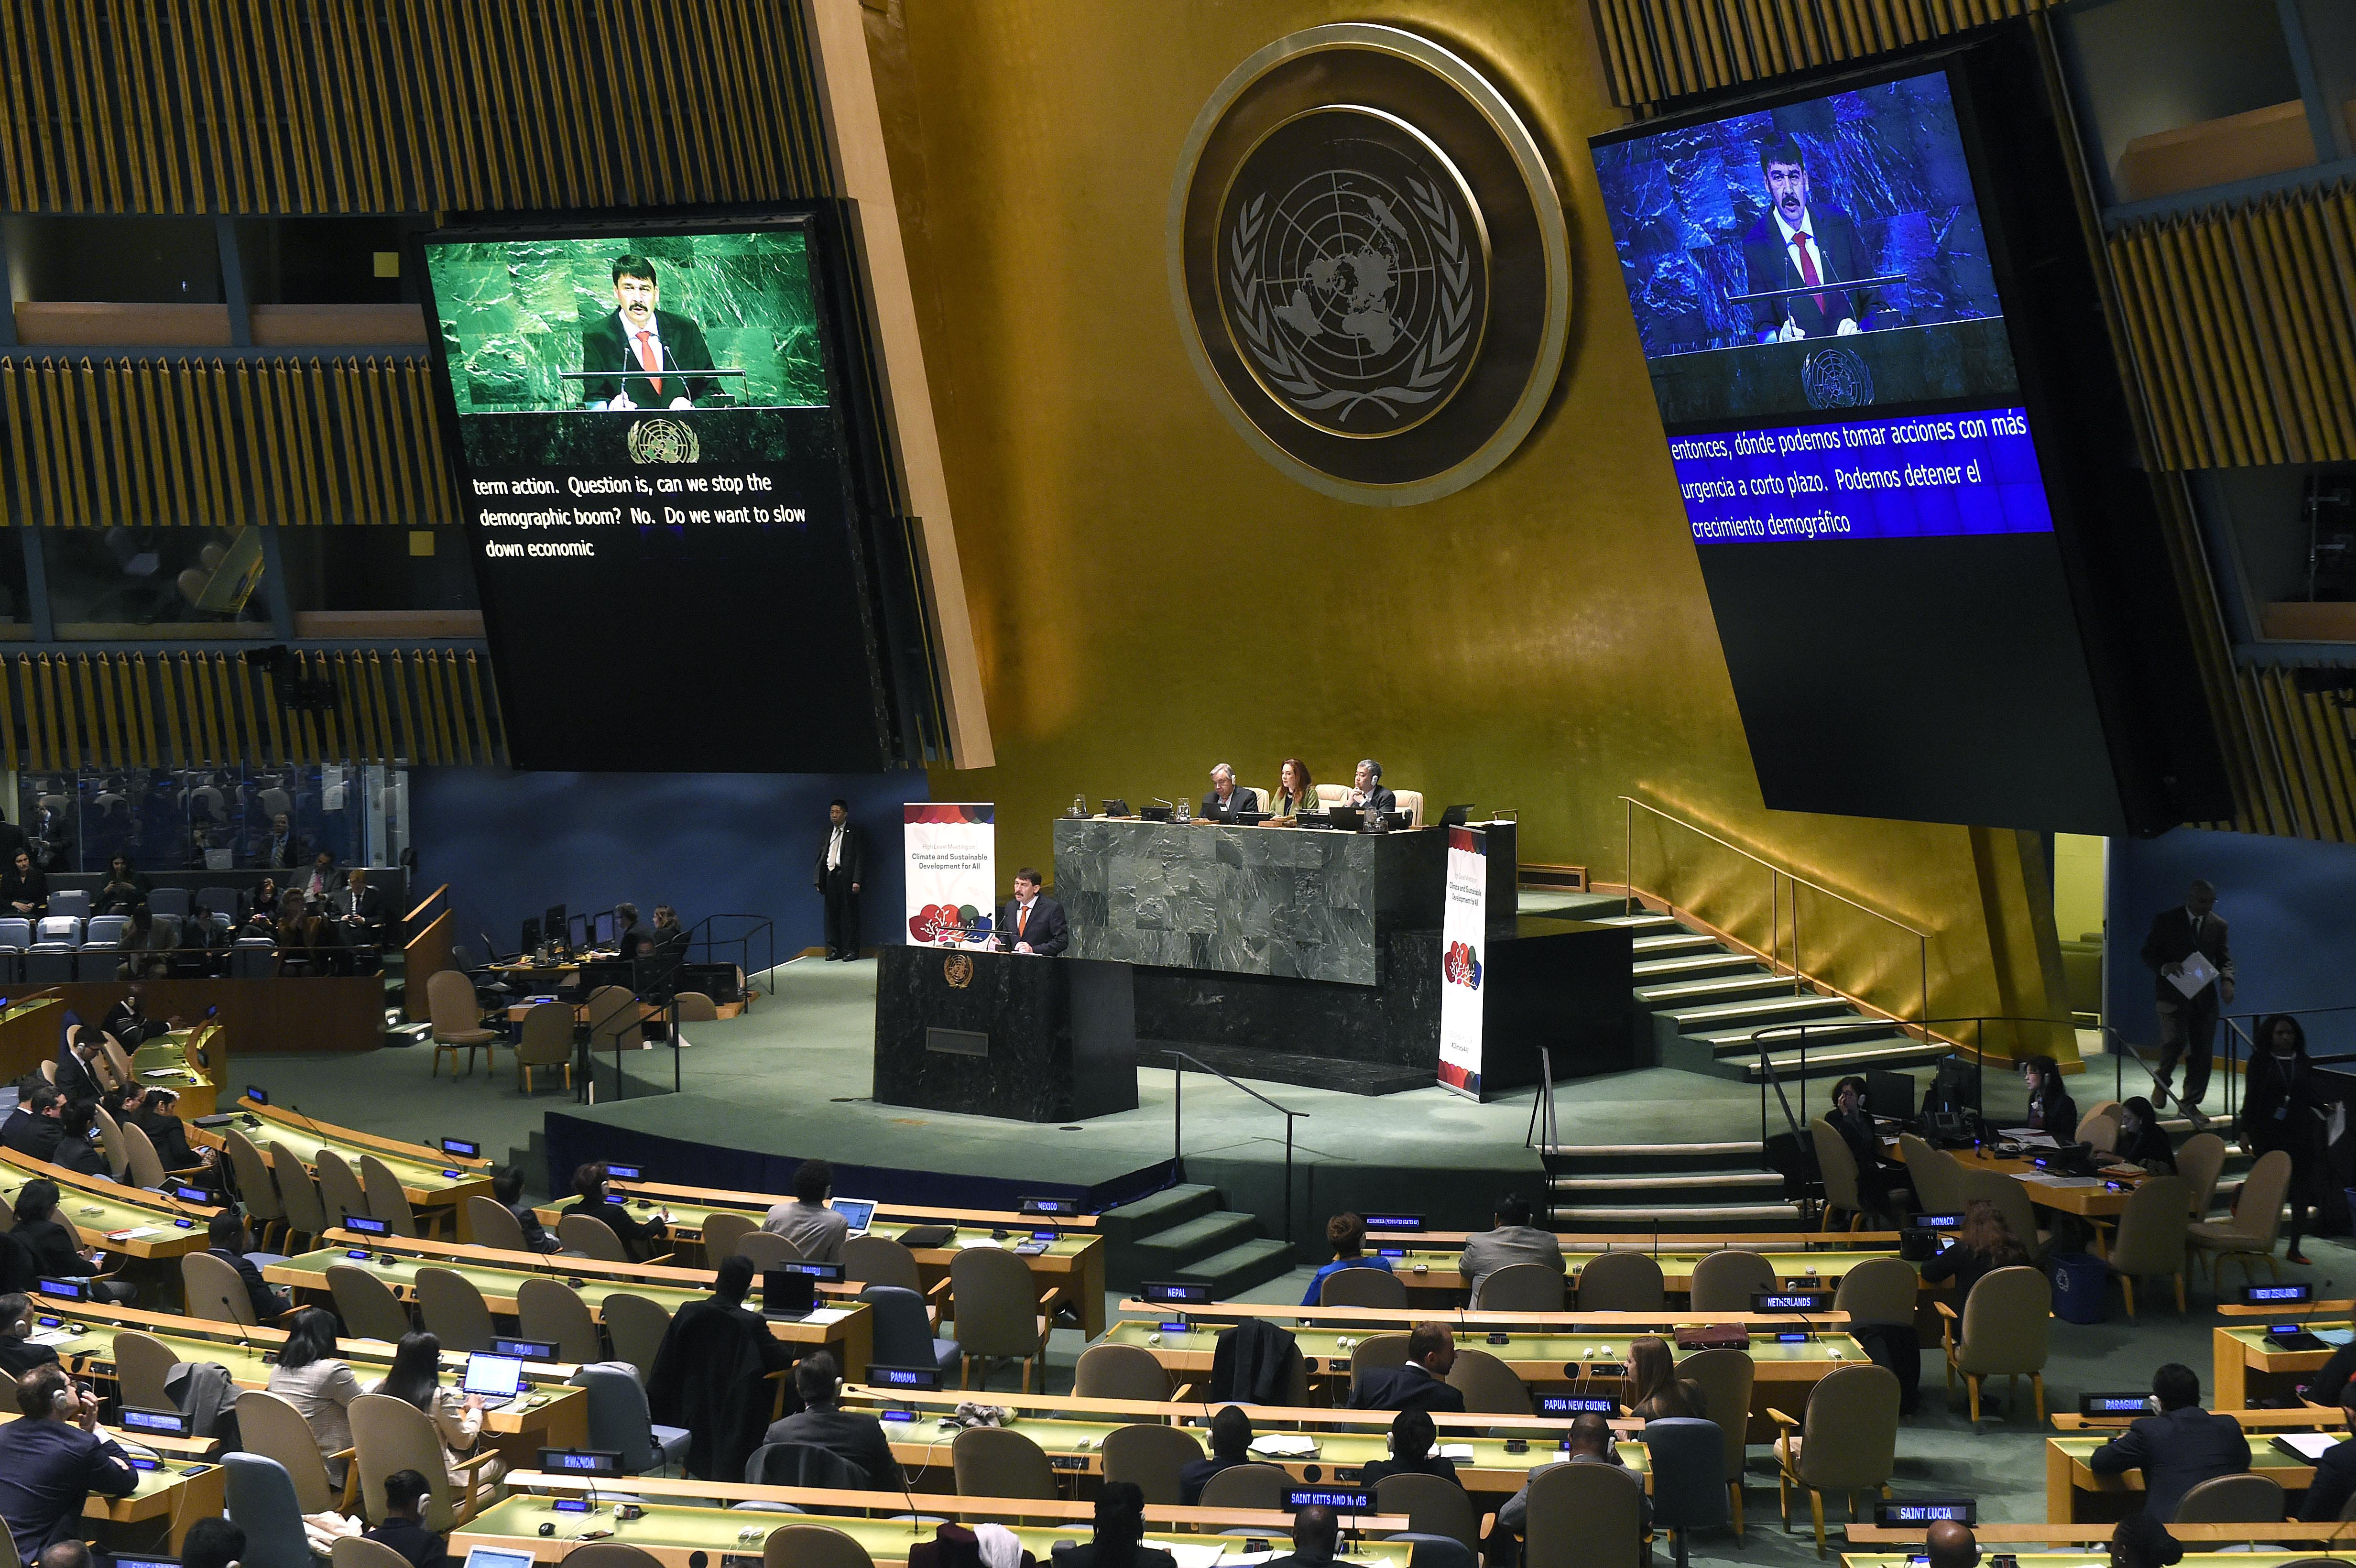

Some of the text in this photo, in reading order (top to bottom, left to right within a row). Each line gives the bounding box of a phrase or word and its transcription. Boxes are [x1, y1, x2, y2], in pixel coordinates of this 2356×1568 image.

[1671, 408, 2027, 460] entonces, dónde podemos tomar acciones con más
[472, 472, 772, 498] term action. Question is, can we stop the
[1681, 458, 1982, 503] urgencia a corto plazo. Podemos detener el
[480, 504, 805, 530] demographic boom? No. Do we want to slow
[1692, 509, 1850, 538] crecimiento demográfico
[486, 539, 595, 557] down economic
[1038, 1201, 1058, 1211] MEXICO
[1931, 1217, 1954, 1226] MONACO
[1167, 1288, 1186, 1298] NEPAL
[2256, 1289, 2271, 1299] NEW
[1767, 1297, 1811, 1307] NETHERLANDS
[890, 1372, 916, 1384] PANAMA
[1545, 1400, 1611, 1411] PAPUA NEW GUINEA
[2105, 1399, 2143, 1410] PARAGUAY
[565, 1456, 596, 1469] RWANDA
[1291, 1493, 1311, 1504] SAINT
[1312, 1494, 1331, 1505] KITTS
[1332, 1494, 1346, 1505] AND
[1900, 1507, 1952, 1519] SAINT LUCIA
